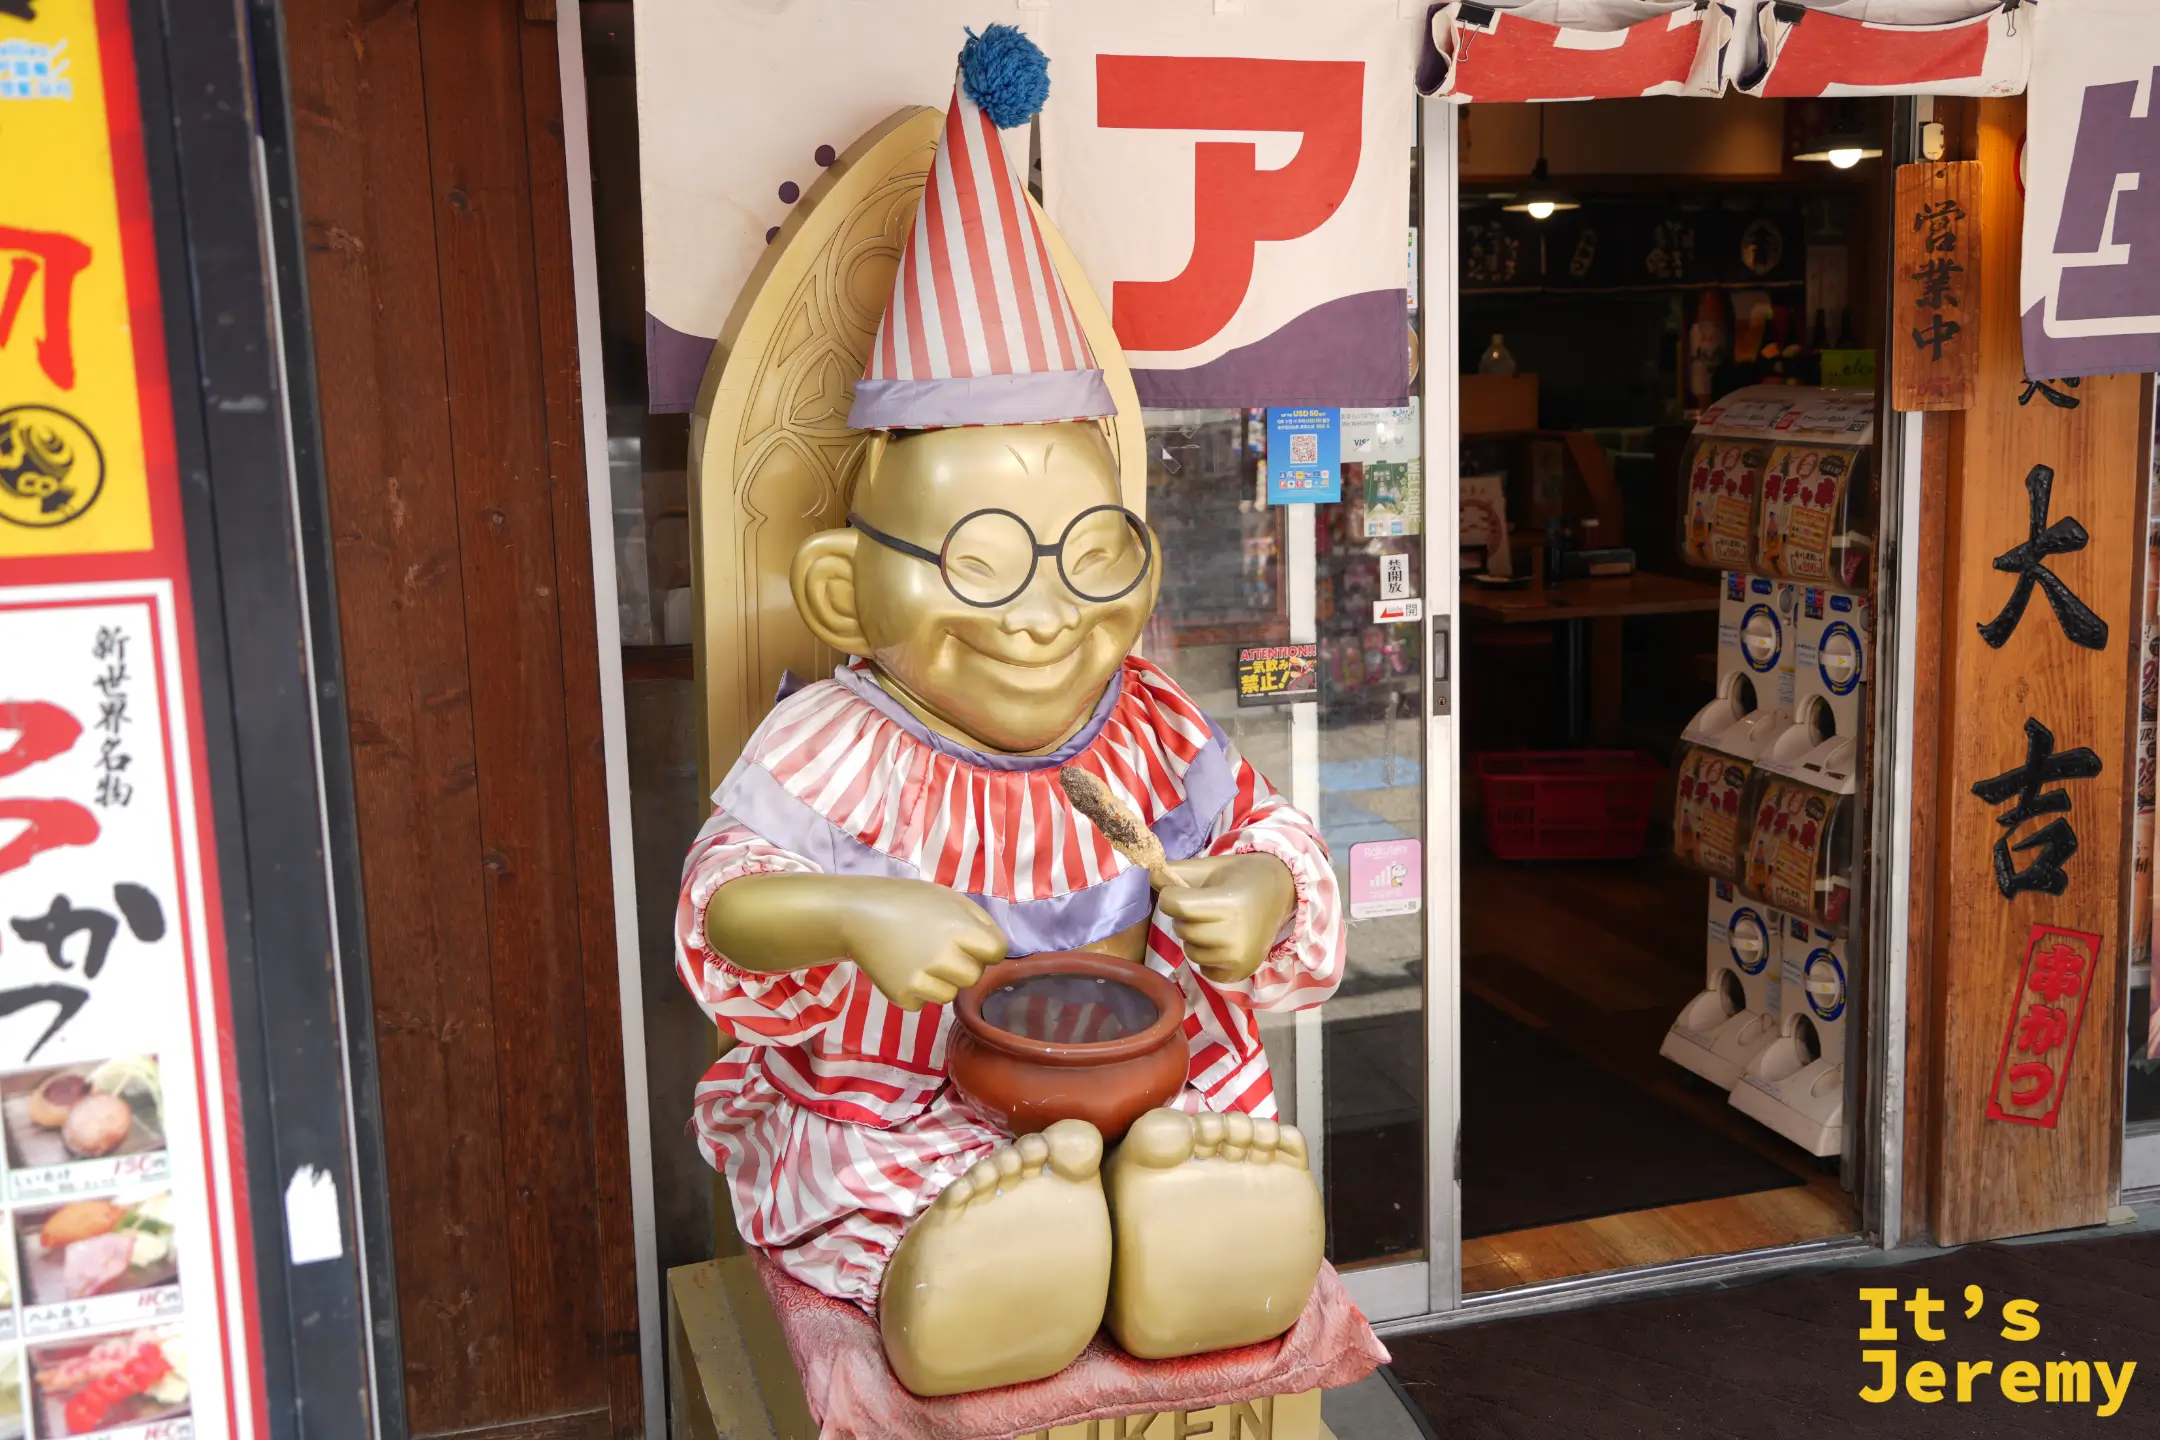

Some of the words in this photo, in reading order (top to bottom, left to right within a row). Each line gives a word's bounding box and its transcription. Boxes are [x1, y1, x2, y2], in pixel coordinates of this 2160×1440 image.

[1096, 53, 1365, 351] ア
[1911, 199, 1966, 362] 営業中
[1240, 644, 1317, 661] ATTENTION!!
[1405, 604, 1418, 616] 開
[1239, 659, 1289, 674] 一気飲み
[92, 625, 133, 808] 新世界名物
[1364, 845, 1407, 857] Rakuten
[2009, 943, 2085, 1107] 串かつ
